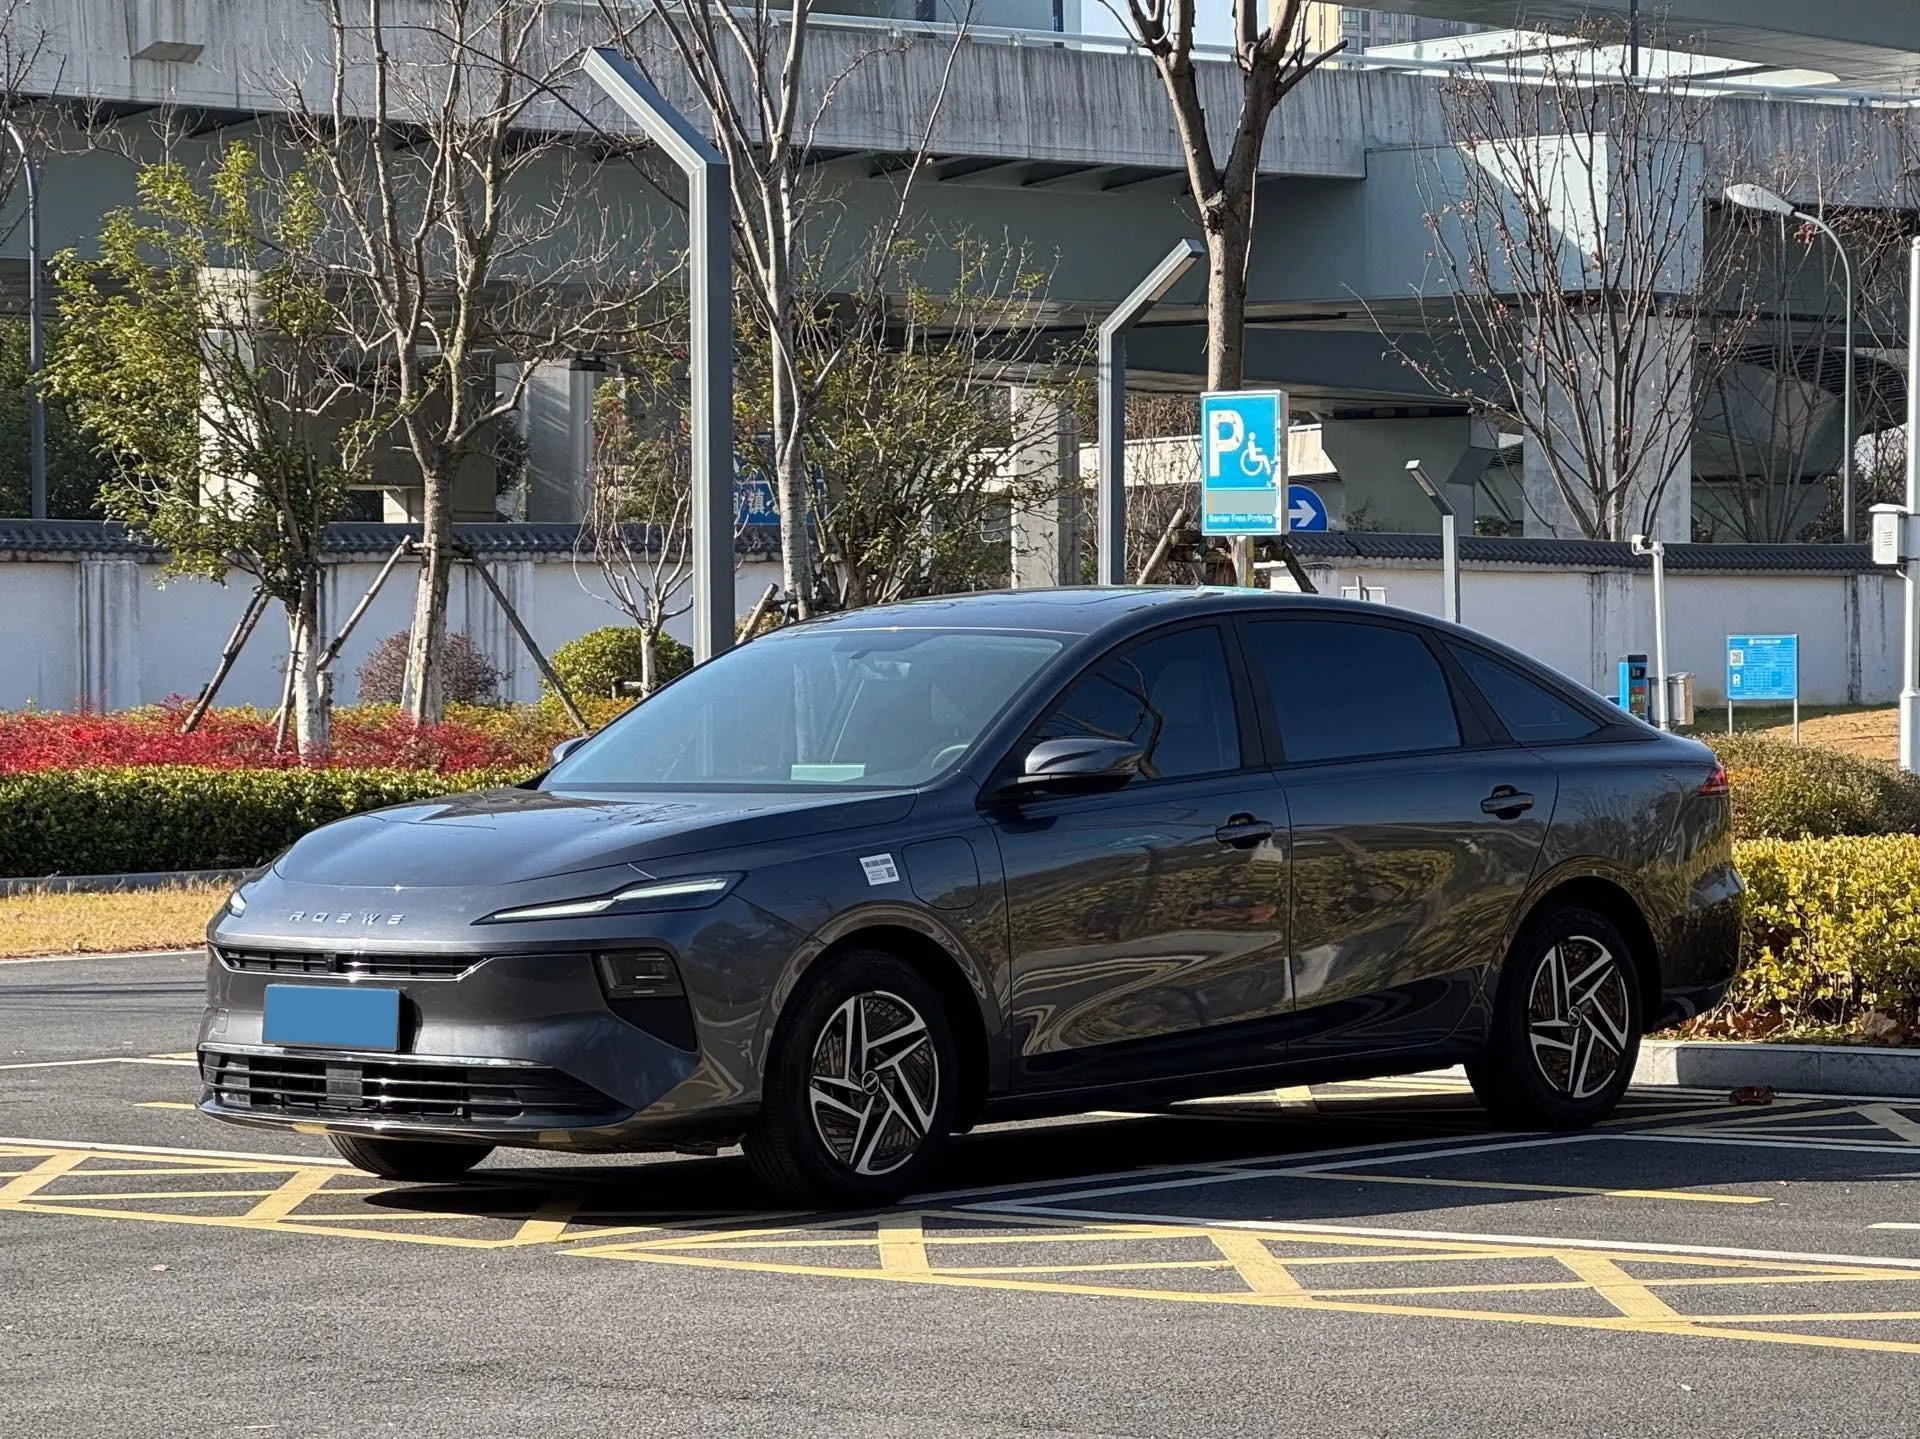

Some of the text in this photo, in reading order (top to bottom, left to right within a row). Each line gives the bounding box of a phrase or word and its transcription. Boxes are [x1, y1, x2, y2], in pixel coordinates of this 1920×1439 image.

[1209, 409, 1245, 477] P
[1208, 514, 1273, 525] Barrier Free Parking
[289, 911, 405, 925] ROEWE
